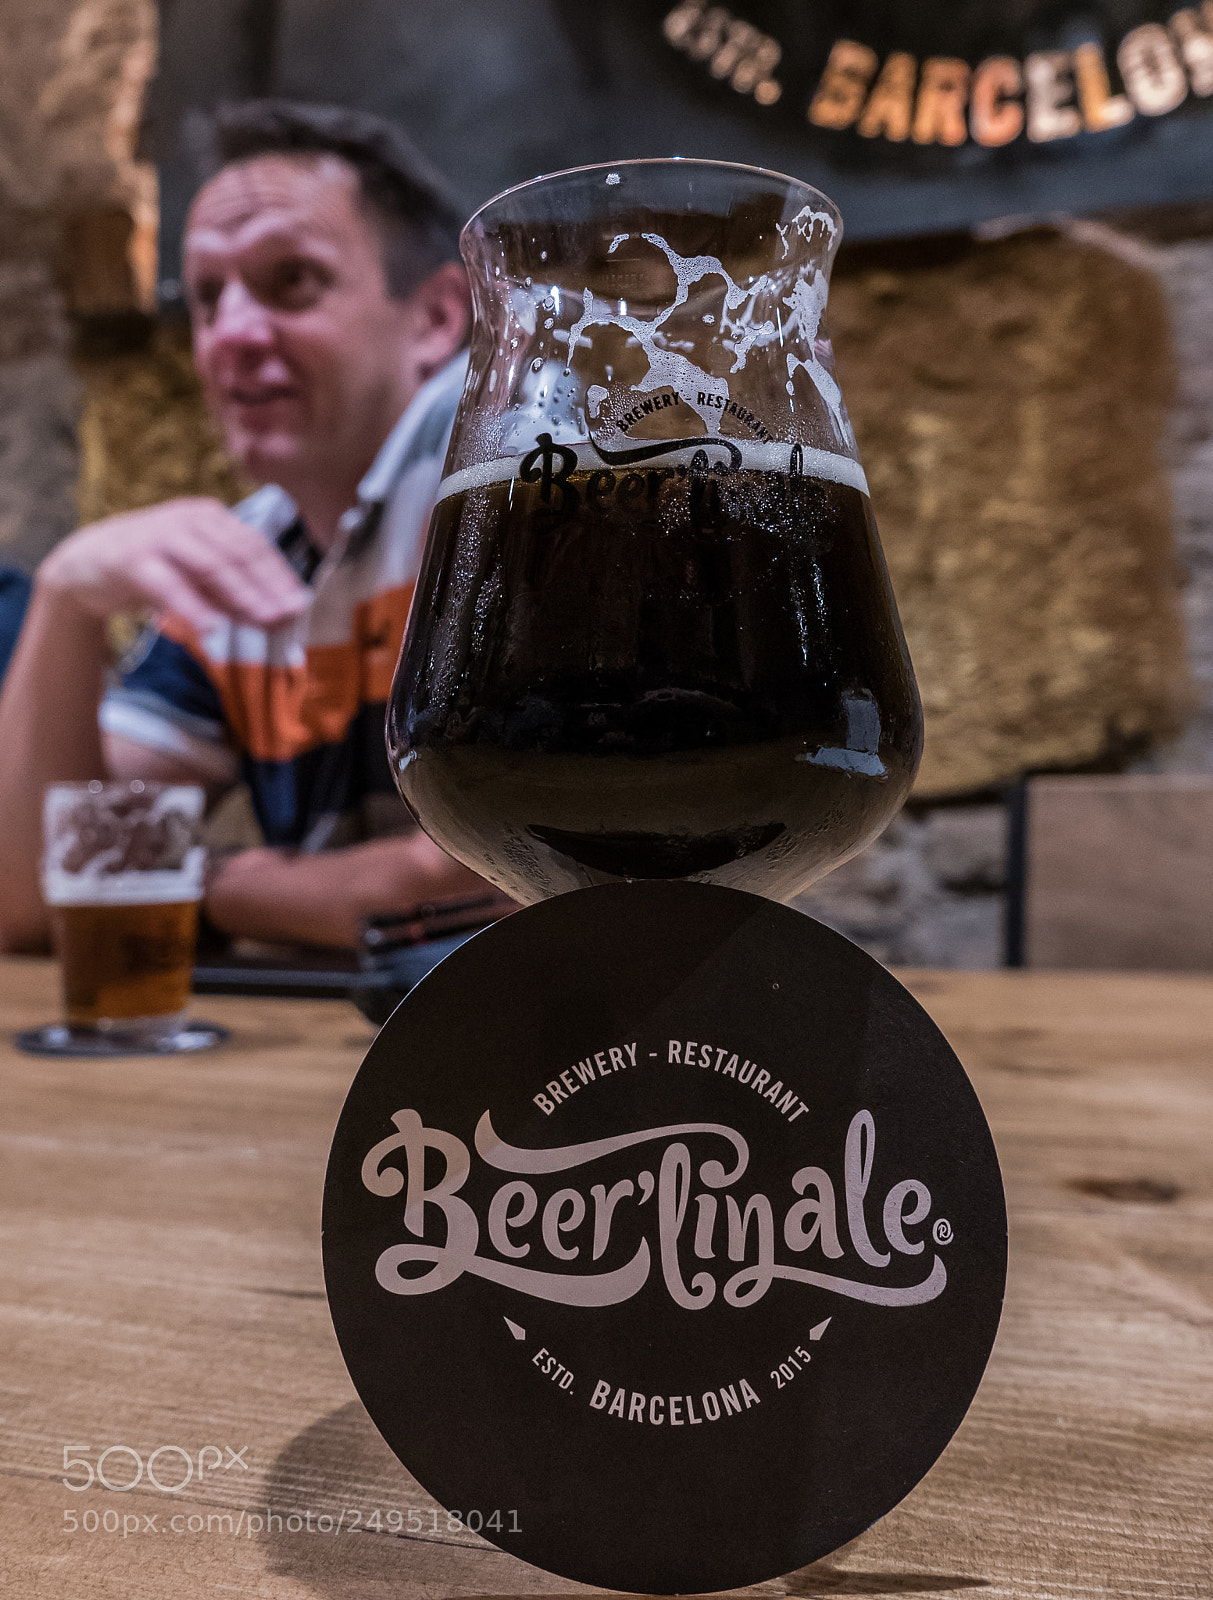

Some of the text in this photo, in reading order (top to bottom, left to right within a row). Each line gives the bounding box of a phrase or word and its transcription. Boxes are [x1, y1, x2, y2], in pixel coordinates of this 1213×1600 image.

[616, 391, 681, 432] BREWERY
[697, 390, 775, 444] RESTAURANT
[532, 1042, 638, 1117] BREWERY
[668, 1039, 811, 1123] RESTAURANT
[361, 1108, 948, 1311] Beer'linale
[531, 1345, 812, 1426] ESTD. BARCELONA 2015
